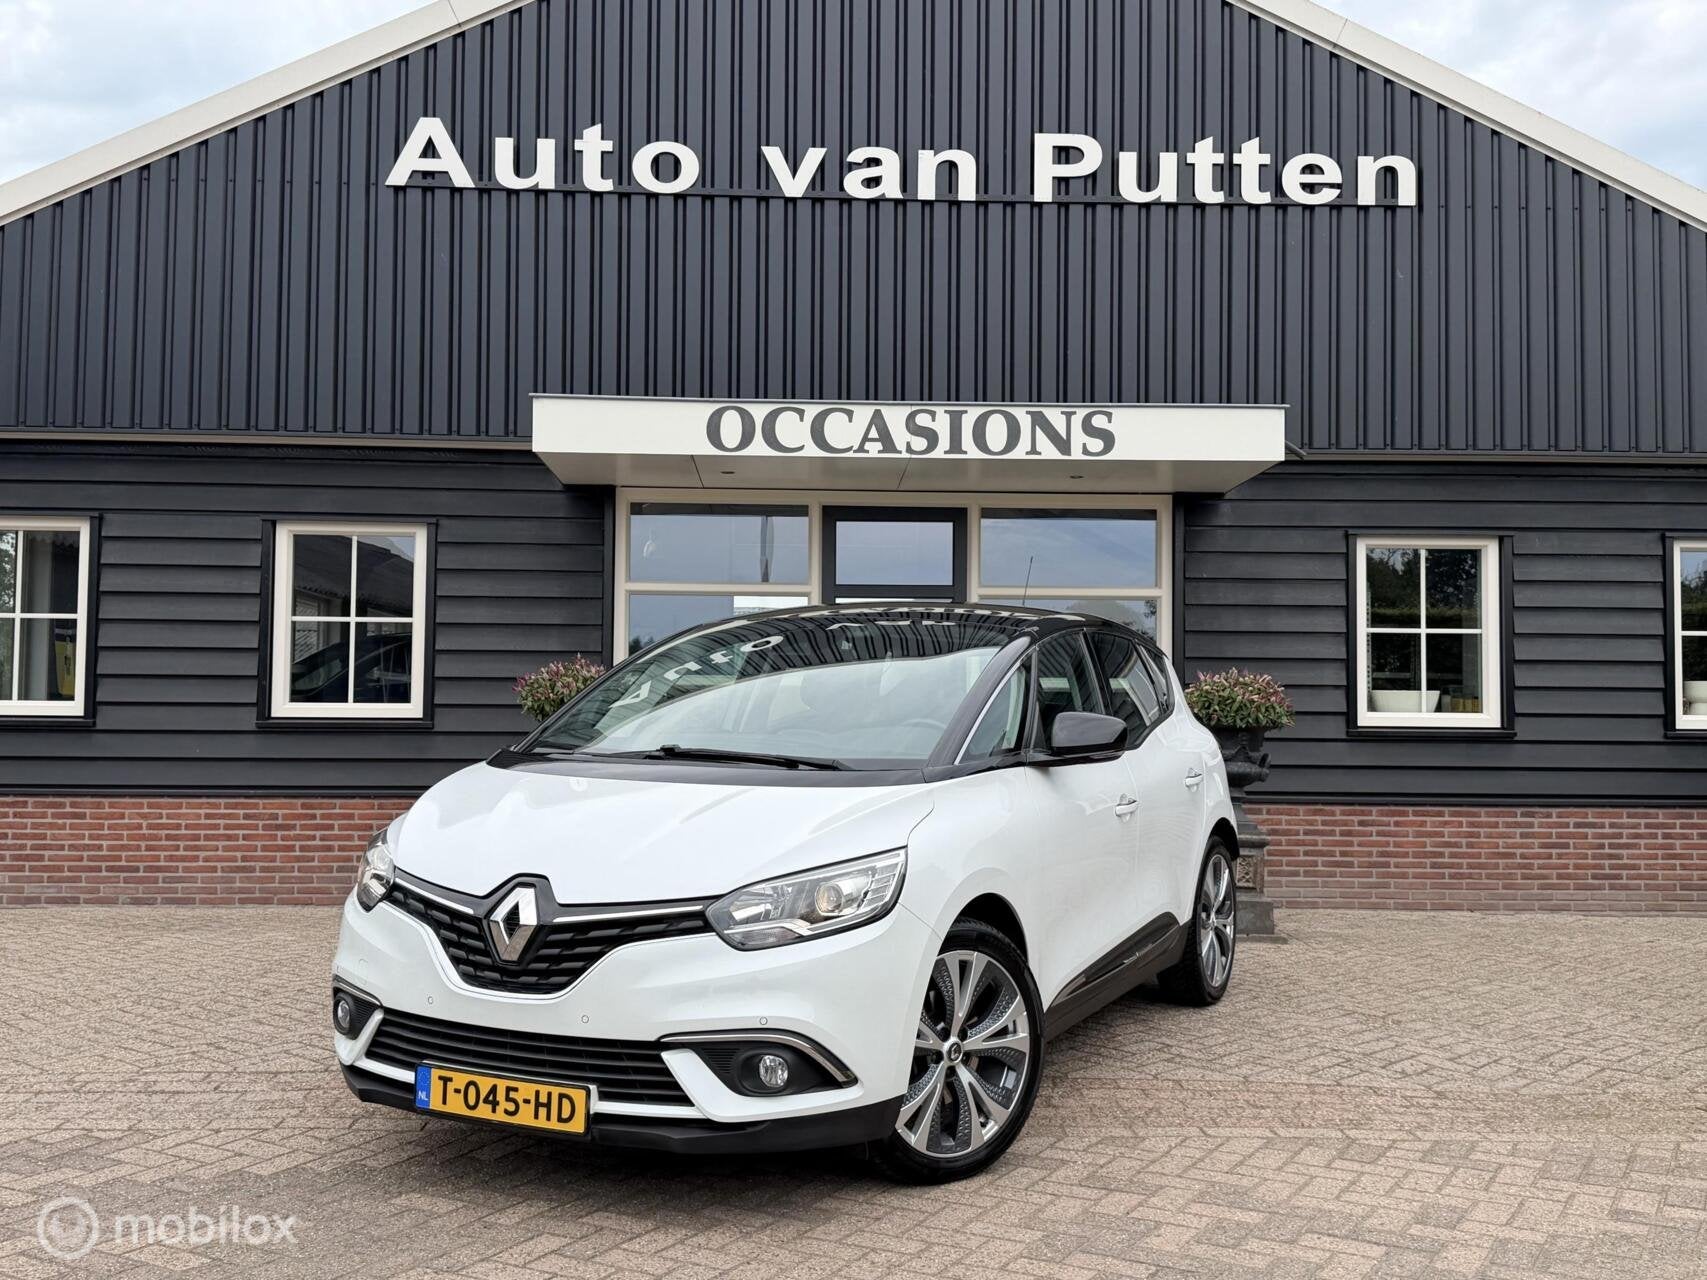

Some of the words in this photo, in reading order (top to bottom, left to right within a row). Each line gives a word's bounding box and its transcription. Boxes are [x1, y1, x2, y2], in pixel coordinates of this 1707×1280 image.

[385, 116, 700, 195] Auto
[760, 145, 978, 202] van
[1033, 132, 1417, 207] Putten
[705, 405, 1116, 459] OCCASIONS
[417, 1090, 429, 1101] NL
[437, 1074, 577, 1125] T-045-HD
